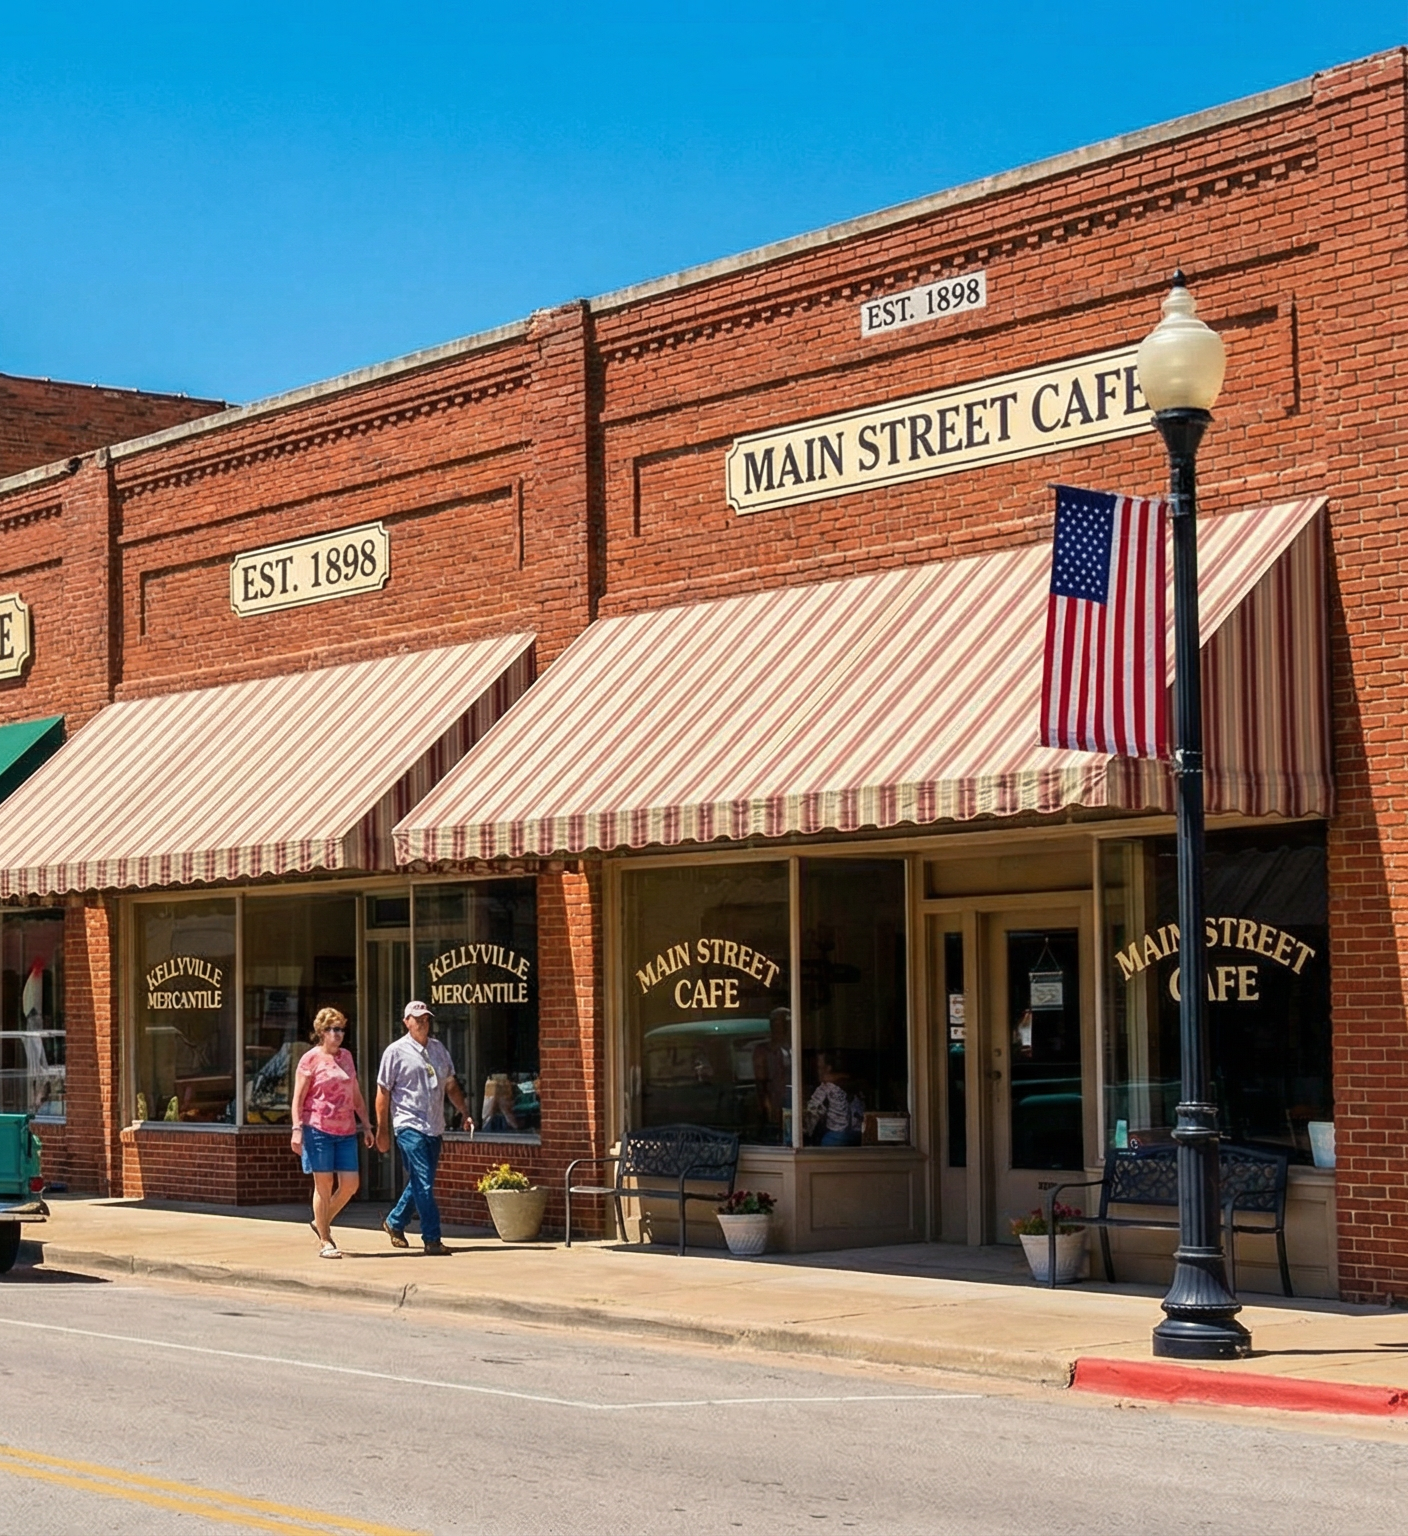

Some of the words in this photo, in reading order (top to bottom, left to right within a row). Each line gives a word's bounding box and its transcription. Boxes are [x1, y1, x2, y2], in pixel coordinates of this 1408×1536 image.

[866, 296, 915, 330] EST.
[926, 278, 981, 316] 1898
[743, 431, 846, 496] MAIN
[857, 392, 1018, 473] STREET
[1031, 363, 1153, 434] CAFE
[242, 555, 299, 602] EST.
[310, 539, 377, 588] 1898
[428, 944, 530, 982] KELLYVILLE
[635, 942, 691, 994] MAIN
[697, 938, 780, 988] STREET
[1205, 917, 1316, 975] STREET
[146, 957, 223, 991] KELLYVILLE
[431, 983, 529, 1004] MERCANTILE
[674, 978, 740, 1009] CAFE
[147, 990, 222, 1009] MERCANTILE
